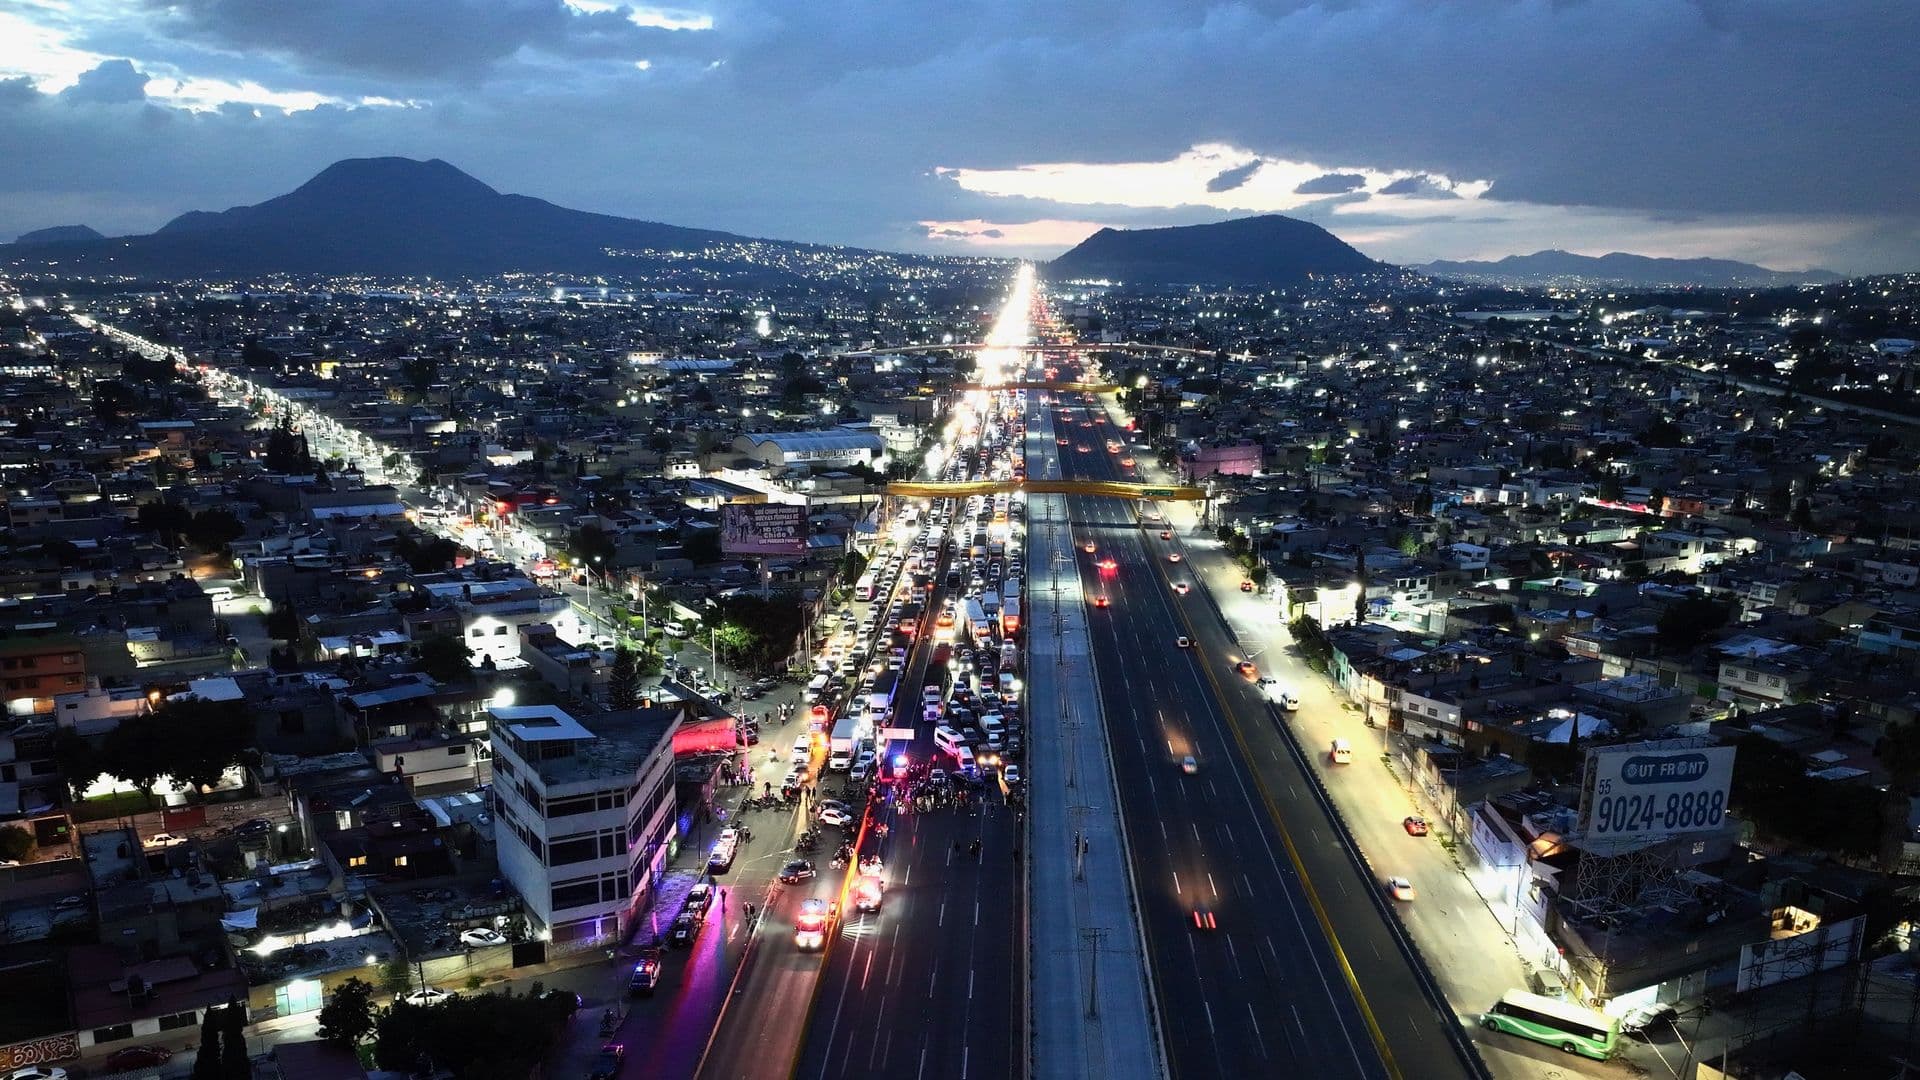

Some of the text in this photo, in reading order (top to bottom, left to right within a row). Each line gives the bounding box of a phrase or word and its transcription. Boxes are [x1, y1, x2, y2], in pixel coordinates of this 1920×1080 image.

[1627, 761, 1706, 777] OUT FRONT
[1598, 779, 1612, 794] 55
[1597, 790, 1724, 833] 9024-8888
